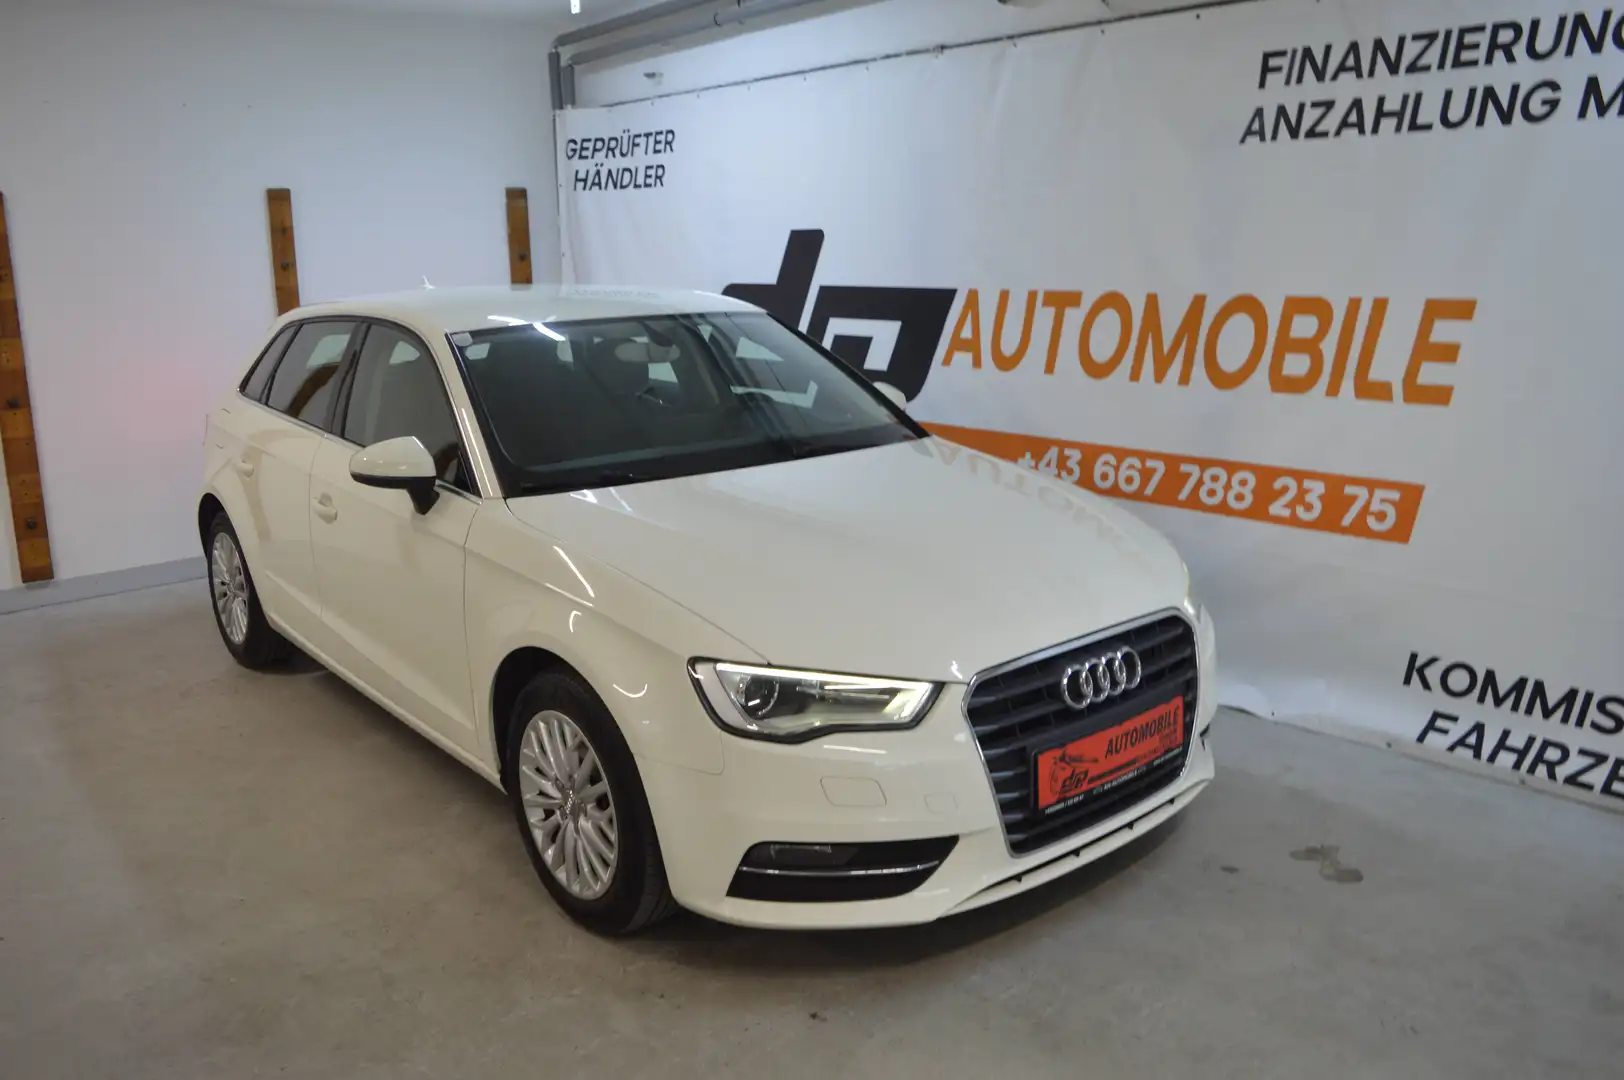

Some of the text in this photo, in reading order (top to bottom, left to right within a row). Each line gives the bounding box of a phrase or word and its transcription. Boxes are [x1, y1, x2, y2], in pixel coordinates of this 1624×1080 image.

[565, 129, 676, 160] GEPRÜFTER
[1239, 79, 1562, 145] ANZAHLUNG
[573, 162, 666, 191] HÄNDLER
[941, 287, 1478, 406] AUTOMOBILE
[1017, 446, 1401, 532] +43 667 788 23 75
[1402, 651, 1624, 735] KOMMIS
[1105, 704, 1180, 760] AUTOMOBILE
